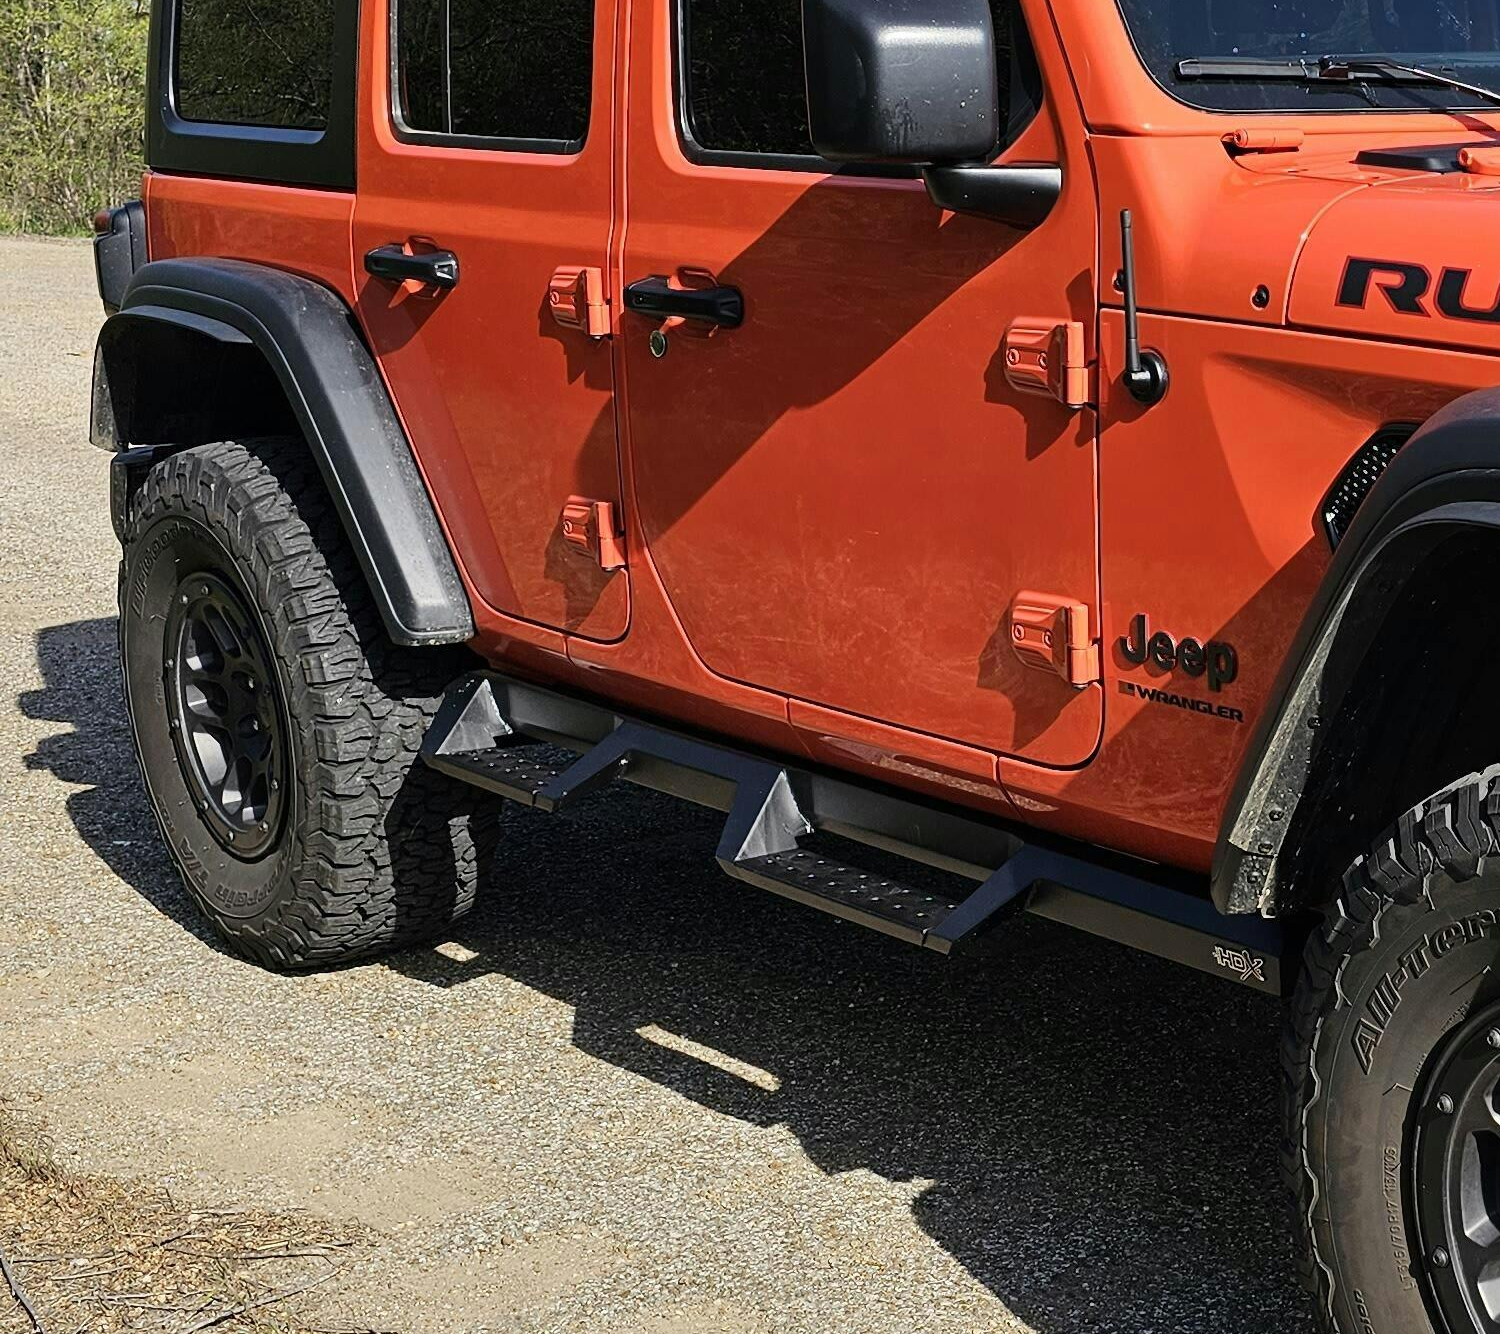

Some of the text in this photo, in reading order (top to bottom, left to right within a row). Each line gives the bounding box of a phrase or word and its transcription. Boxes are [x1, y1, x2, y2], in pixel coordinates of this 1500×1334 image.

[1119, 613, 1239, 693] Jeep
[1135, 684, 1245, 723] WRANGLER
[1213, 945, 1265, 982] HDX
